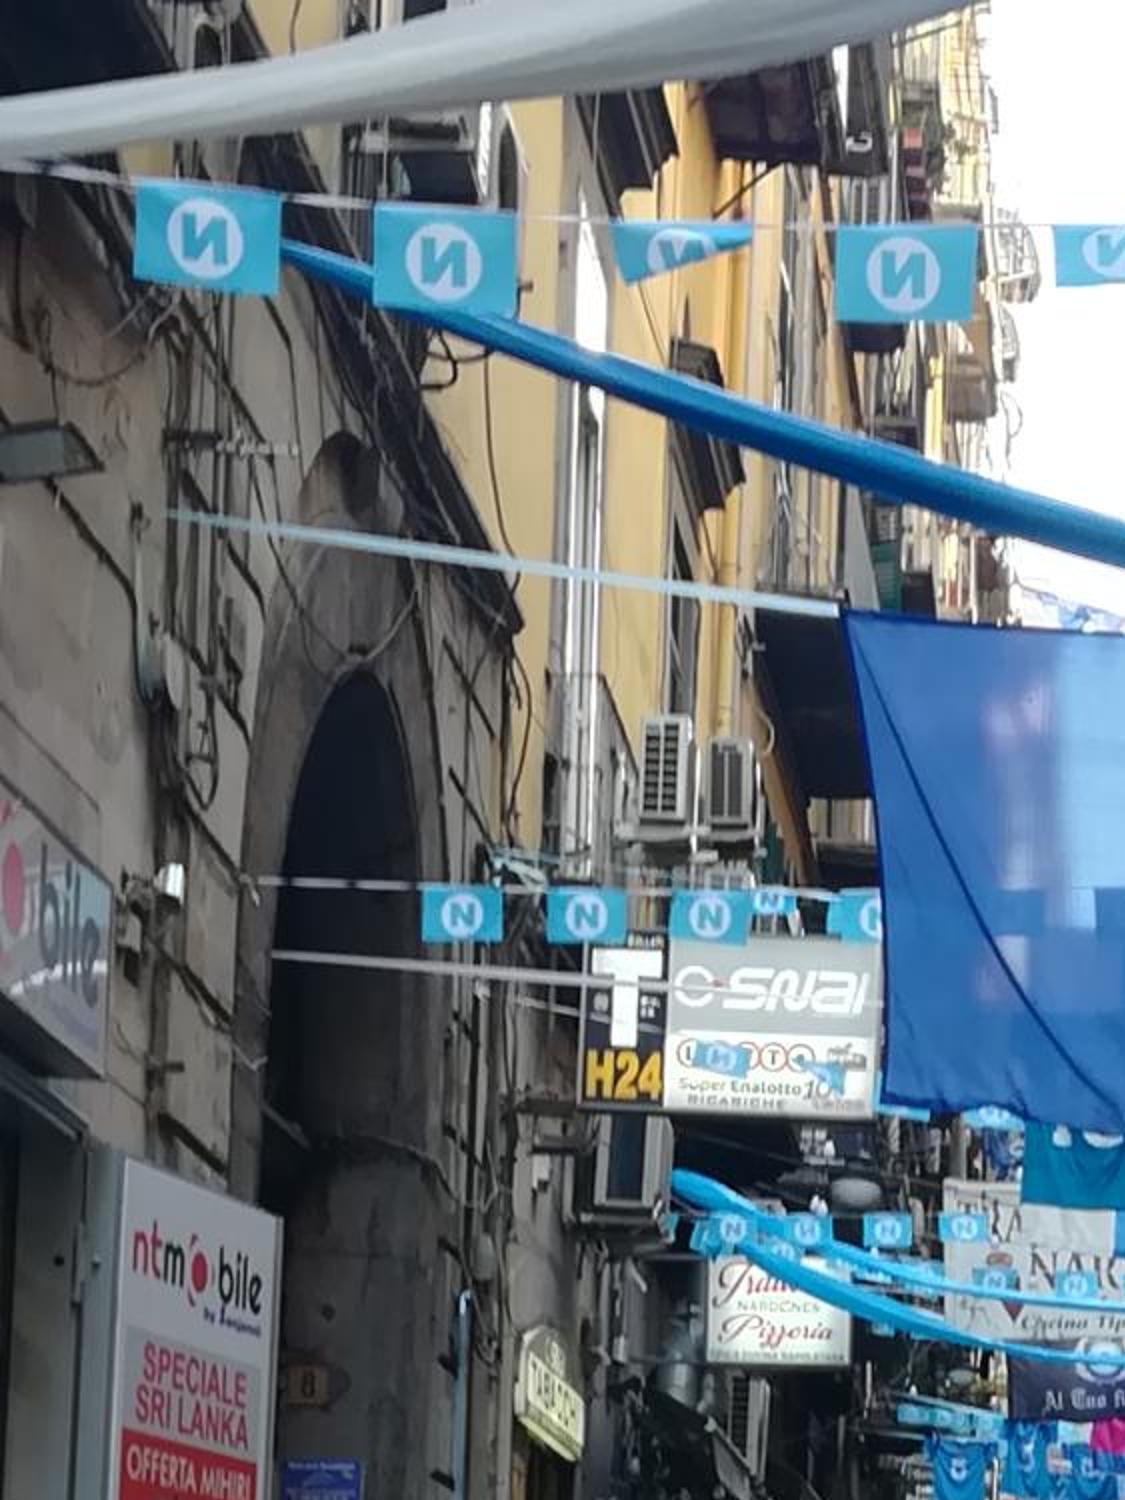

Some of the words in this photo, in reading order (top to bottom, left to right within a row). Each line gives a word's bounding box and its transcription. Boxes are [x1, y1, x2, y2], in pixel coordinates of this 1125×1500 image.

[585, 1051, 662, 1099] H24
[730, 1080, 800, 1096] Enalotto
[143, 1341, 248, 1408] SPECIALE
[135, 1382, 171, 1429] SRI
[177, 1396, 249, 1451] LANKA
[127, 1443, 197, 1493] OFFERTA
